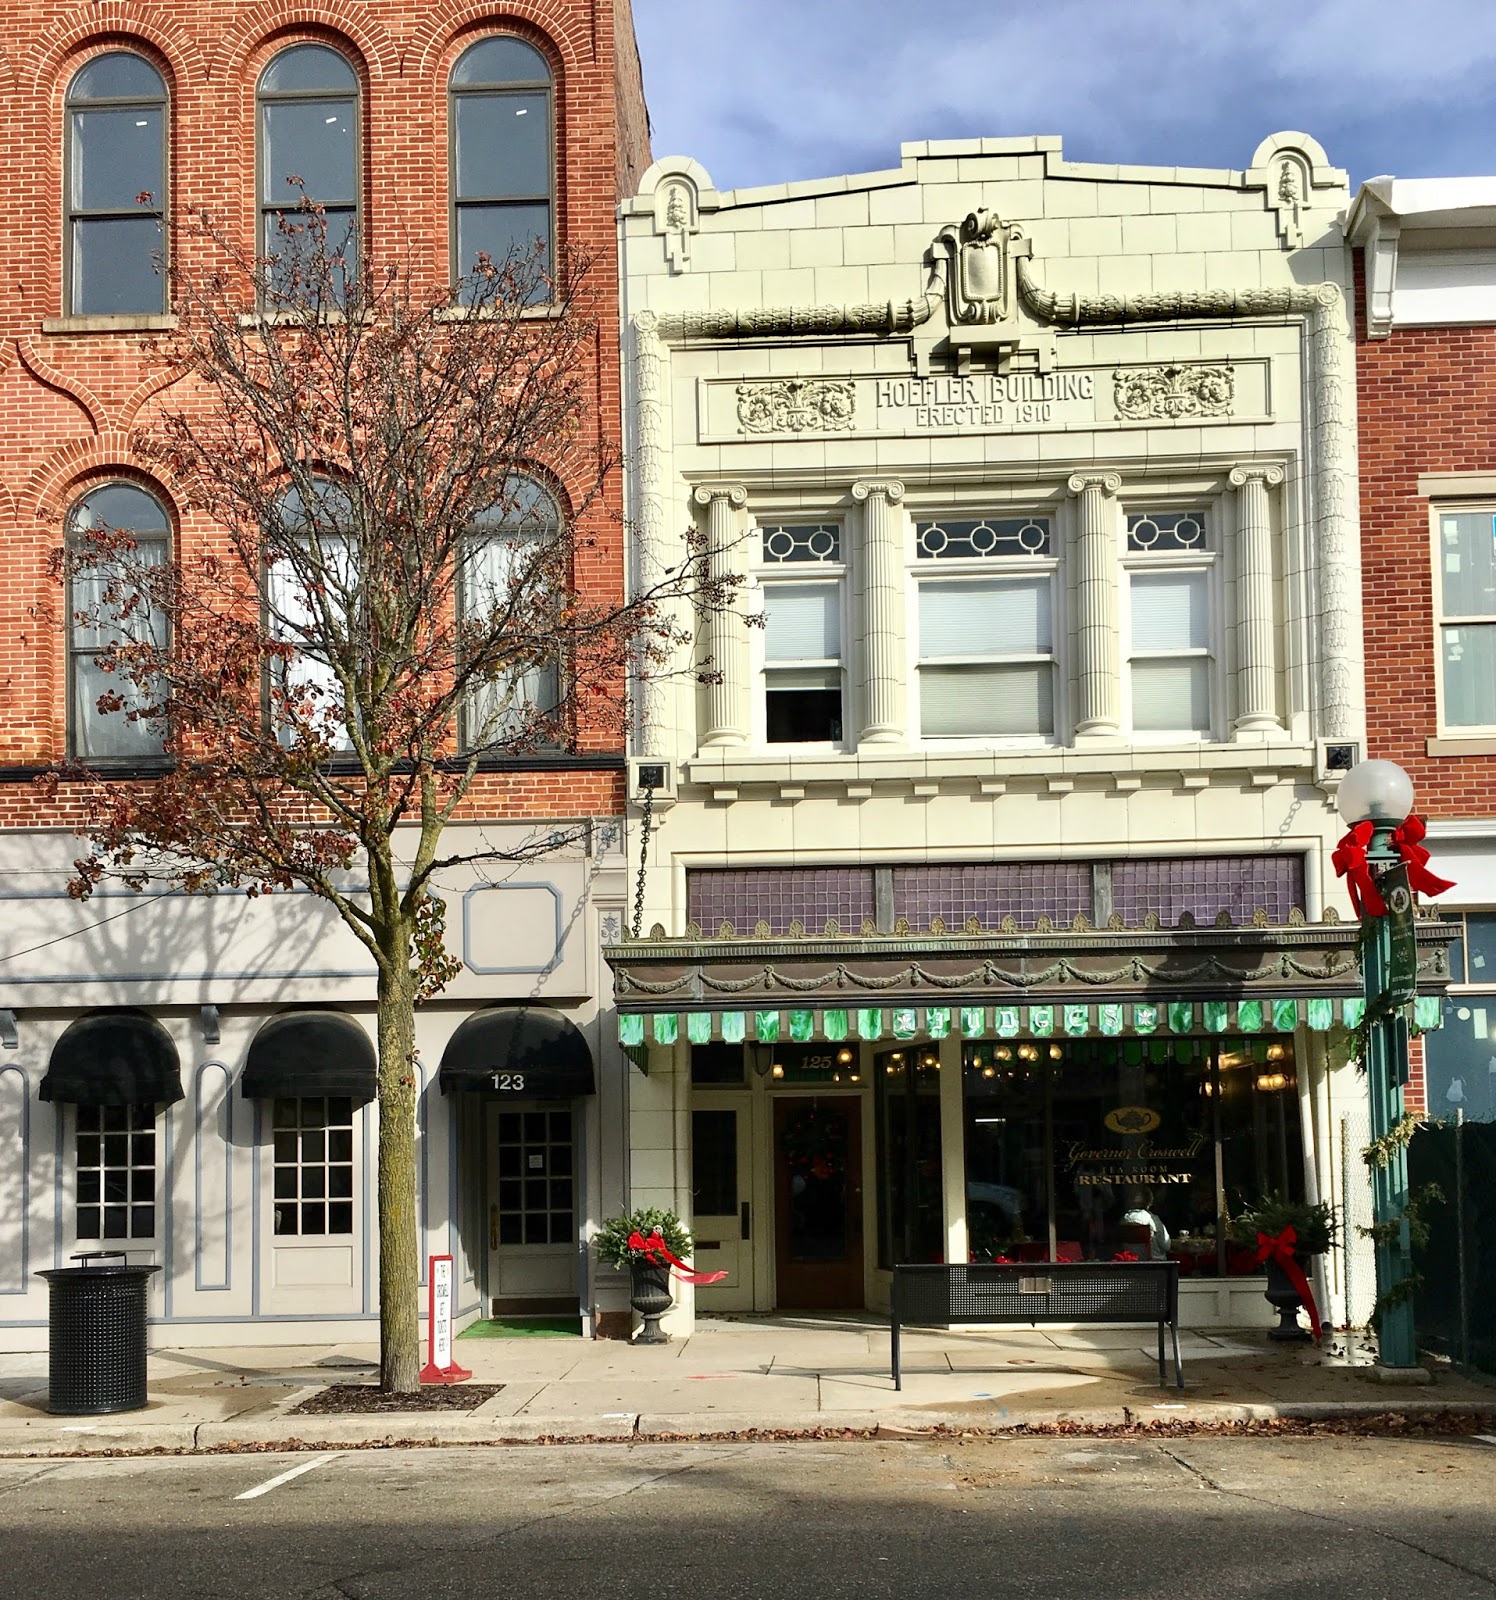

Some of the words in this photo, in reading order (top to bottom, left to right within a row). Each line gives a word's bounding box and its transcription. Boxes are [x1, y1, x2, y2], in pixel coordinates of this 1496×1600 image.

[876, 379, 980, 408] HOEFLER
[989, 374, 1094, 404] BUILDING
[915, 405, 1004, 427] ERECTED
[1015, 404, 1052, 424] 1910
[801, 1055, 833, 1069] 125
[491, 1074, 525, 1091] 123
[1064, 1140, 1132, 1172] Governor
[1132, 1165, 1169, 1174] ROOM
[1078, 1173, 1192, 1186] RESTAURANT
